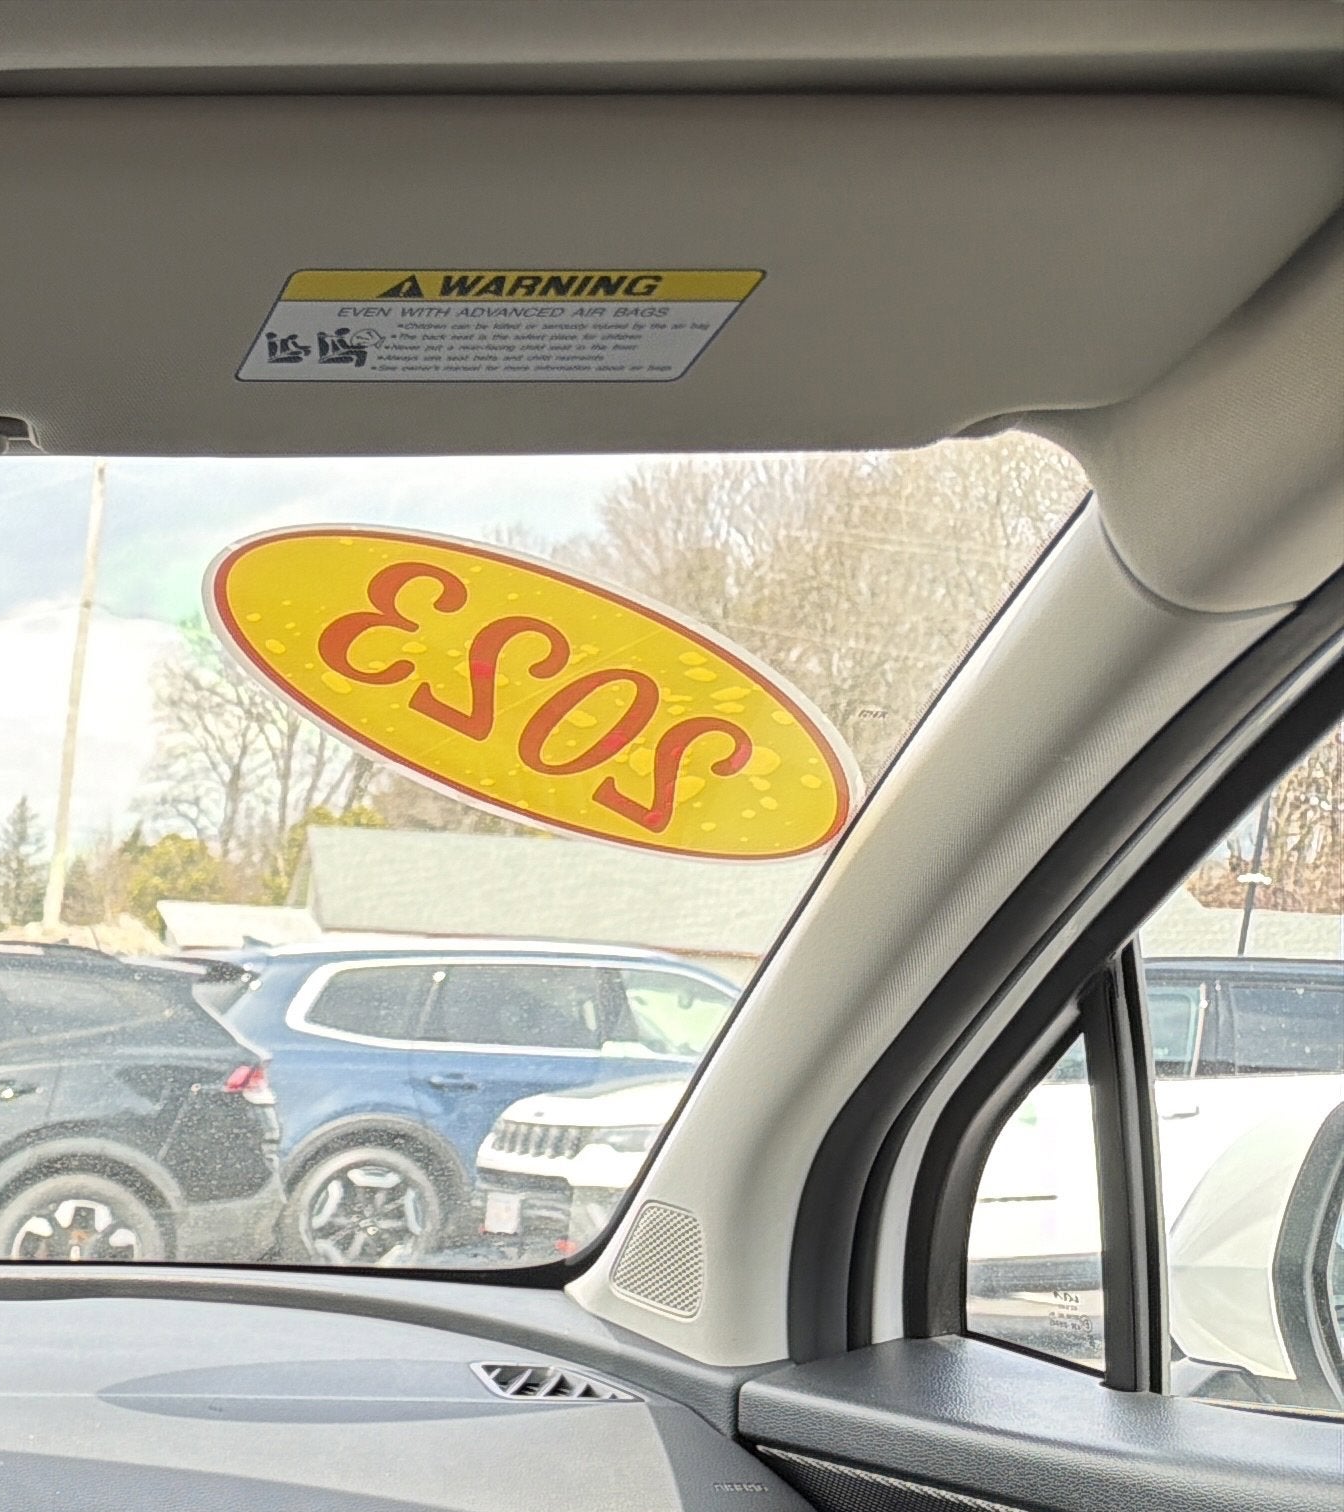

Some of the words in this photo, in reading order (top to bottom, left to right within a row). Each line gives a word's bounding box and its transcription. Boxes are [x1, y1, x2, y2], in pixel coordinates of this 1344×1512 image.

[439, 274, 662, 297] WARNING
[337, 307, 392, 318] EVEN
[401, 307, 451, 318] WITH
[459, 307, 565, 318] ADVANCED
[572, 307, 607, 318] AIR
[612, 307, 670, 318] BAGS
